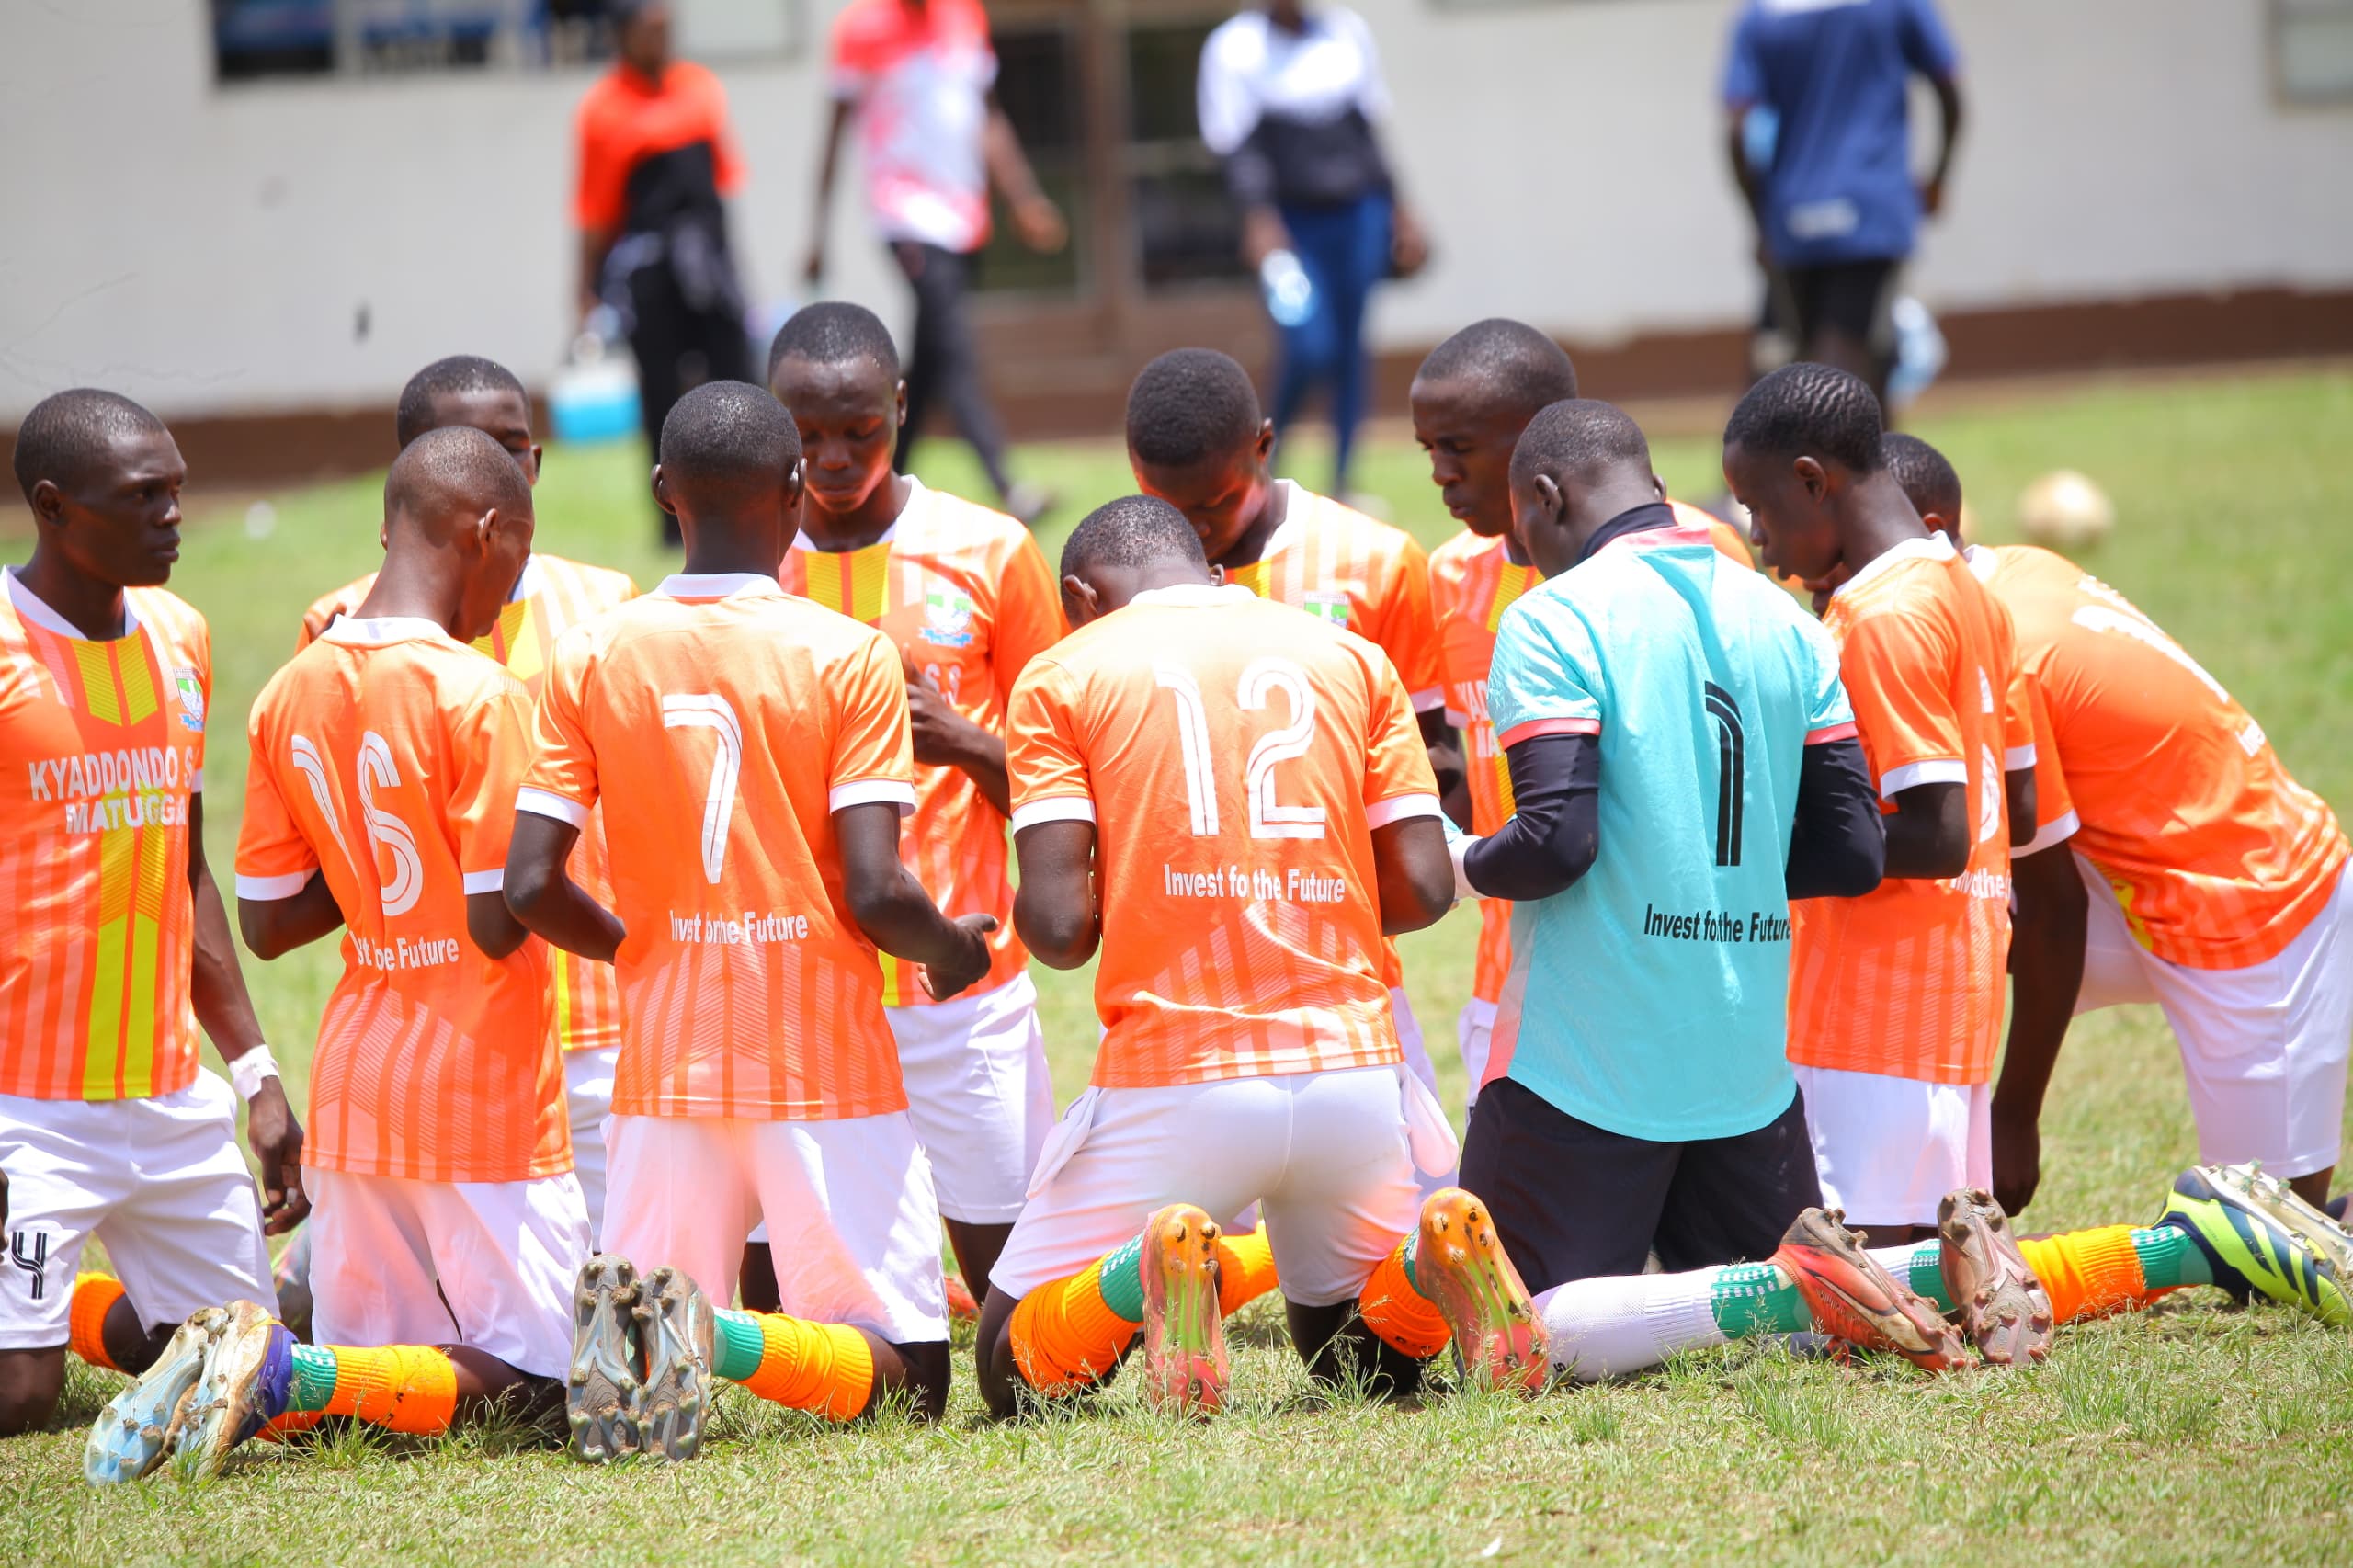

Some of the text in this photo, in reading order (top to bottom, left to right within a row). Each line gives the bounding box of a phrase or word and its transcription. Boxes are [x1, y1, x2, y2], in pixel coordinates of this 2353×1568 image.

[28, 746, 178, 801] KYADDONDO
[1153, 656, 1325, 839] 12
[1705, 680, 1744, 866] 1
[65, 794, 186, 835] MATUGGA
[662, 694, 742, 884] 7
[291, 731, 423, 916] 16
[1164, 864, 1346, 903] Invest fo the Future
[745, 911, 808, 944] Future
[1643, 903, 1700, 940] Invest
[396, 936, 460, 970] Future
[11, 1232, 47, 1300] 4
